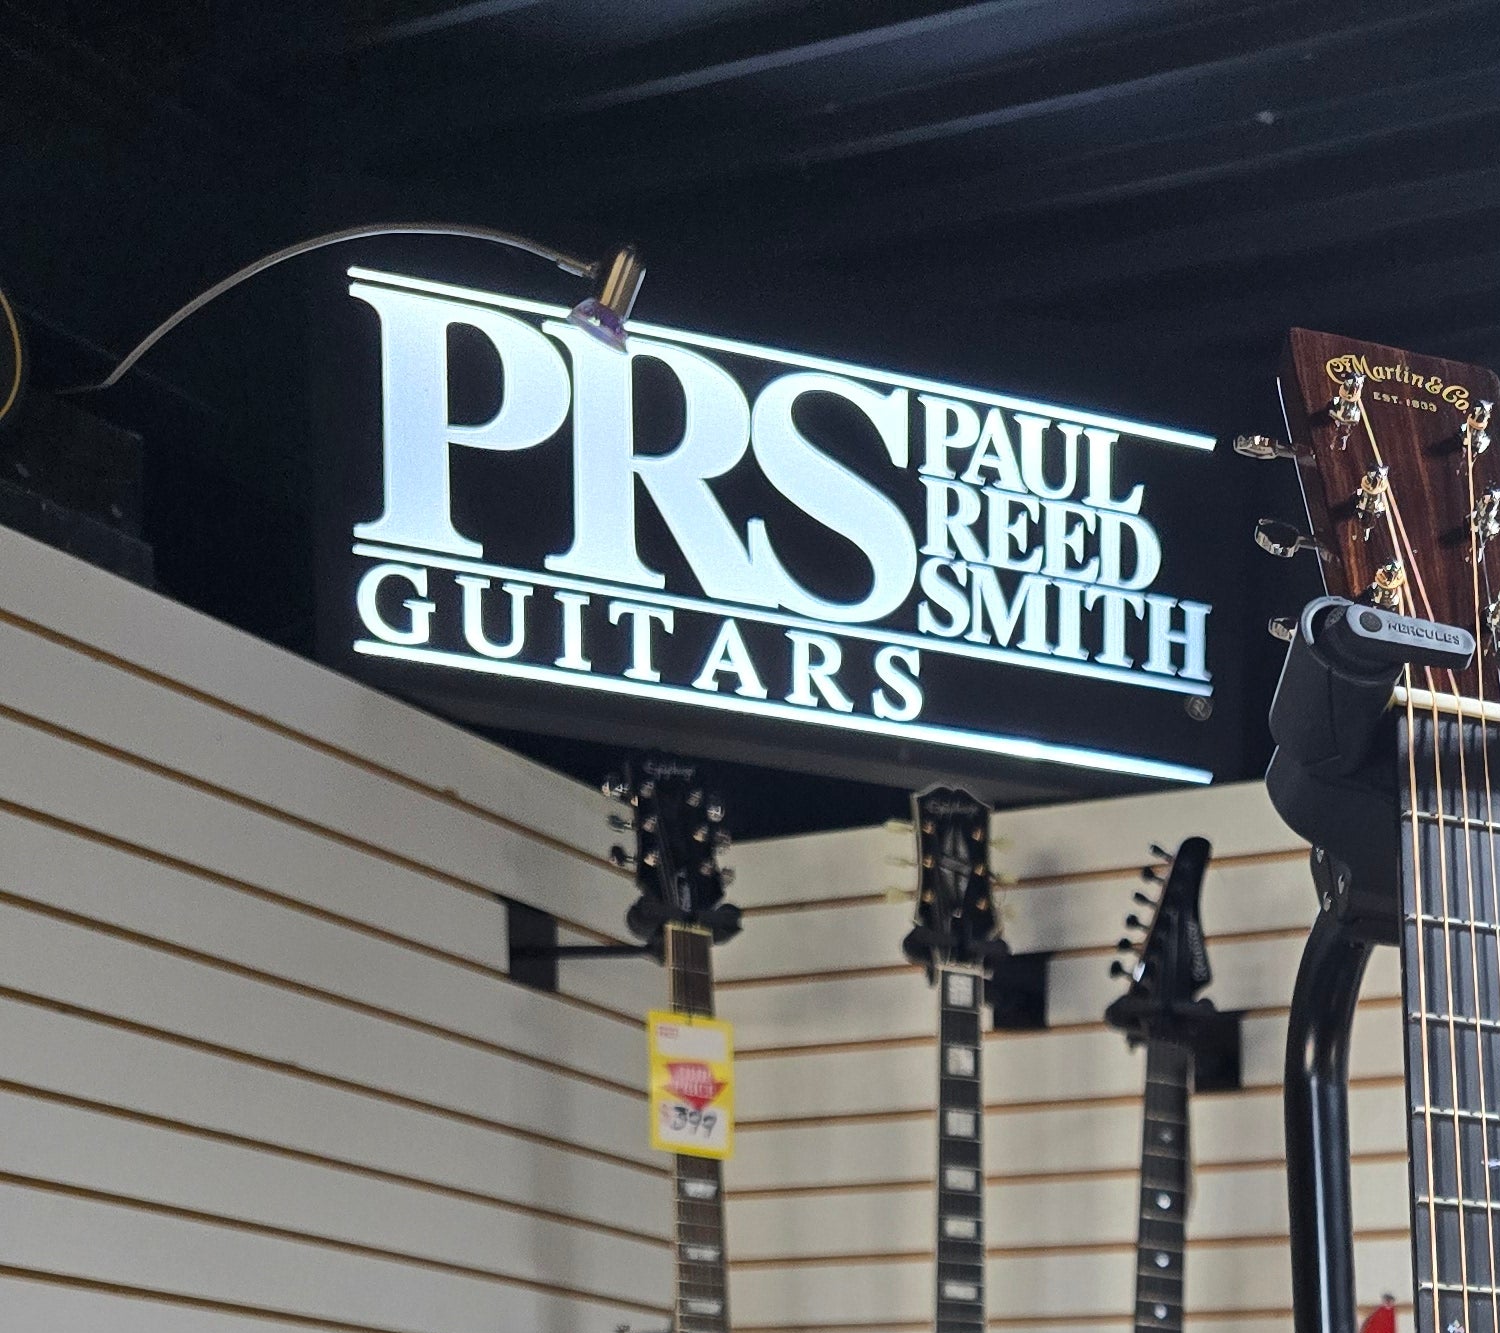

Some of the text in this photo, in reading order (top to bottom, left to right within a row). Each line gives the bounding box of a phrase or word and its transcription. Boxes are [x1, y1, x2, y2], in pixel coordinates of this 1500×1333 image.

[1425, 376, 1444, 395] &
[349, 282, 918, 624] PRS
[919, 394, 1145, 515] PAUL
[919, 476, 1162, 592] REED
[356, 562, 925, 723] GUITARS
[918, 557, 1213, 683] SMITH
